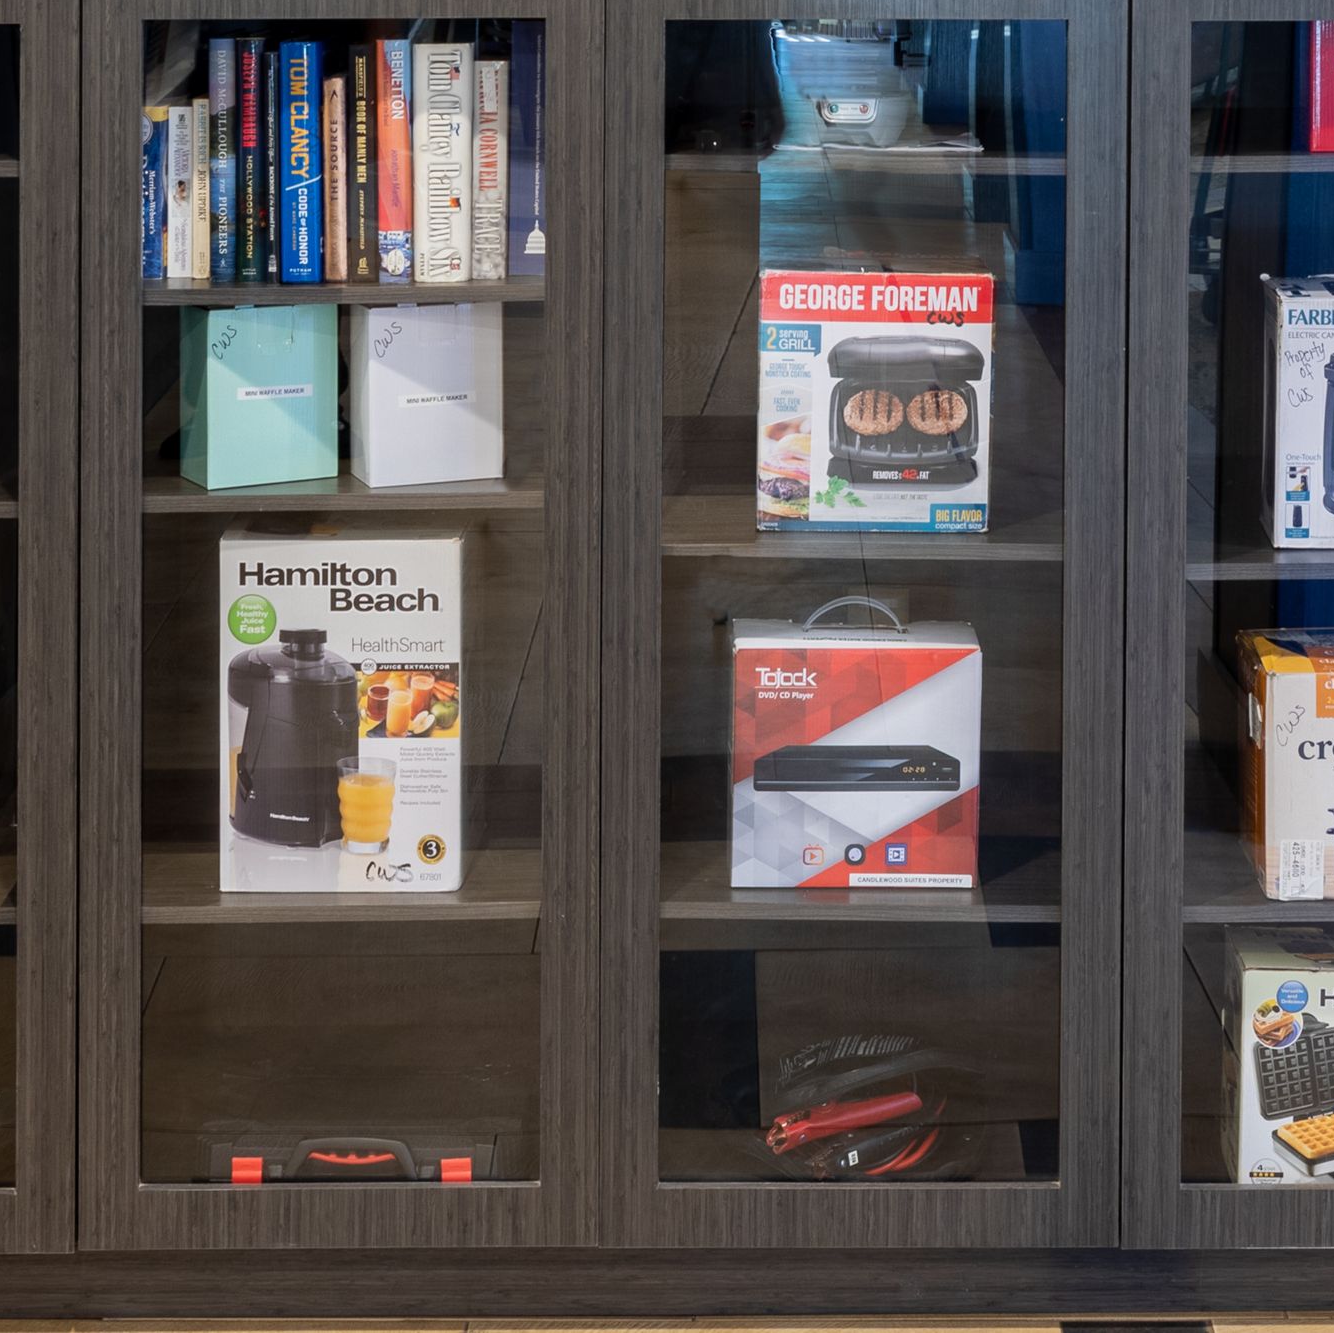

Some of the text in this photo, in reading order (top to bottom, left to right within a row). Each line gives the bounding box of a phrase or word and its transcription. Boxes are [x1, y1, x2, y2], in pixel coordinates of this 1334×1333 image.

[391, 49, 404, 120] BENETTON
[289, 58, 310, 179] TOM CLANCY
[217, 49, 228, 255] DAVID McCULLOUGH PIONEERS
[330, 119, 339, 171] SOURCE
[357, 100, 367, 183] BOOK OF MANLY MEN
[420, 50, 462, 278] Tom Clancy Rainbow Six
[478, 128, 499, 192] CORNWELL
[246, 155, 254, 215] HOLLYWOOD
[330, 176, 338, 201] THE
[148, 169, 157, 234] Merriam-Webster's
[298, 187, 308, 265] CODE HONOR
[474, 197, 503, 254] TRACE
[779, 284, 978, 311] GEORGE FOREMAN
[767, 326, 808, 350] 2 serving
[779, 338, 816, 351] GRILL
[283, 387, 305, 395] MAKER
[445, 394, 468, 402] MAKER
[872, 468, 918, 480] REMOVES 42
[935, 509, 983, 522] BIG FLAVOR
[935, 522, 967, 531] compact
[239, 562, 397, 586] Hamilton
[330, 588, 440, 612] Beach
[239, 624, 266, 634] Fast
[351, 637, 444, 653] HealthSmart
[791, 692, 814, 700] Player
[425, 840, 437, 858] 3
[929, 877, 964, 885] PROPERTY
